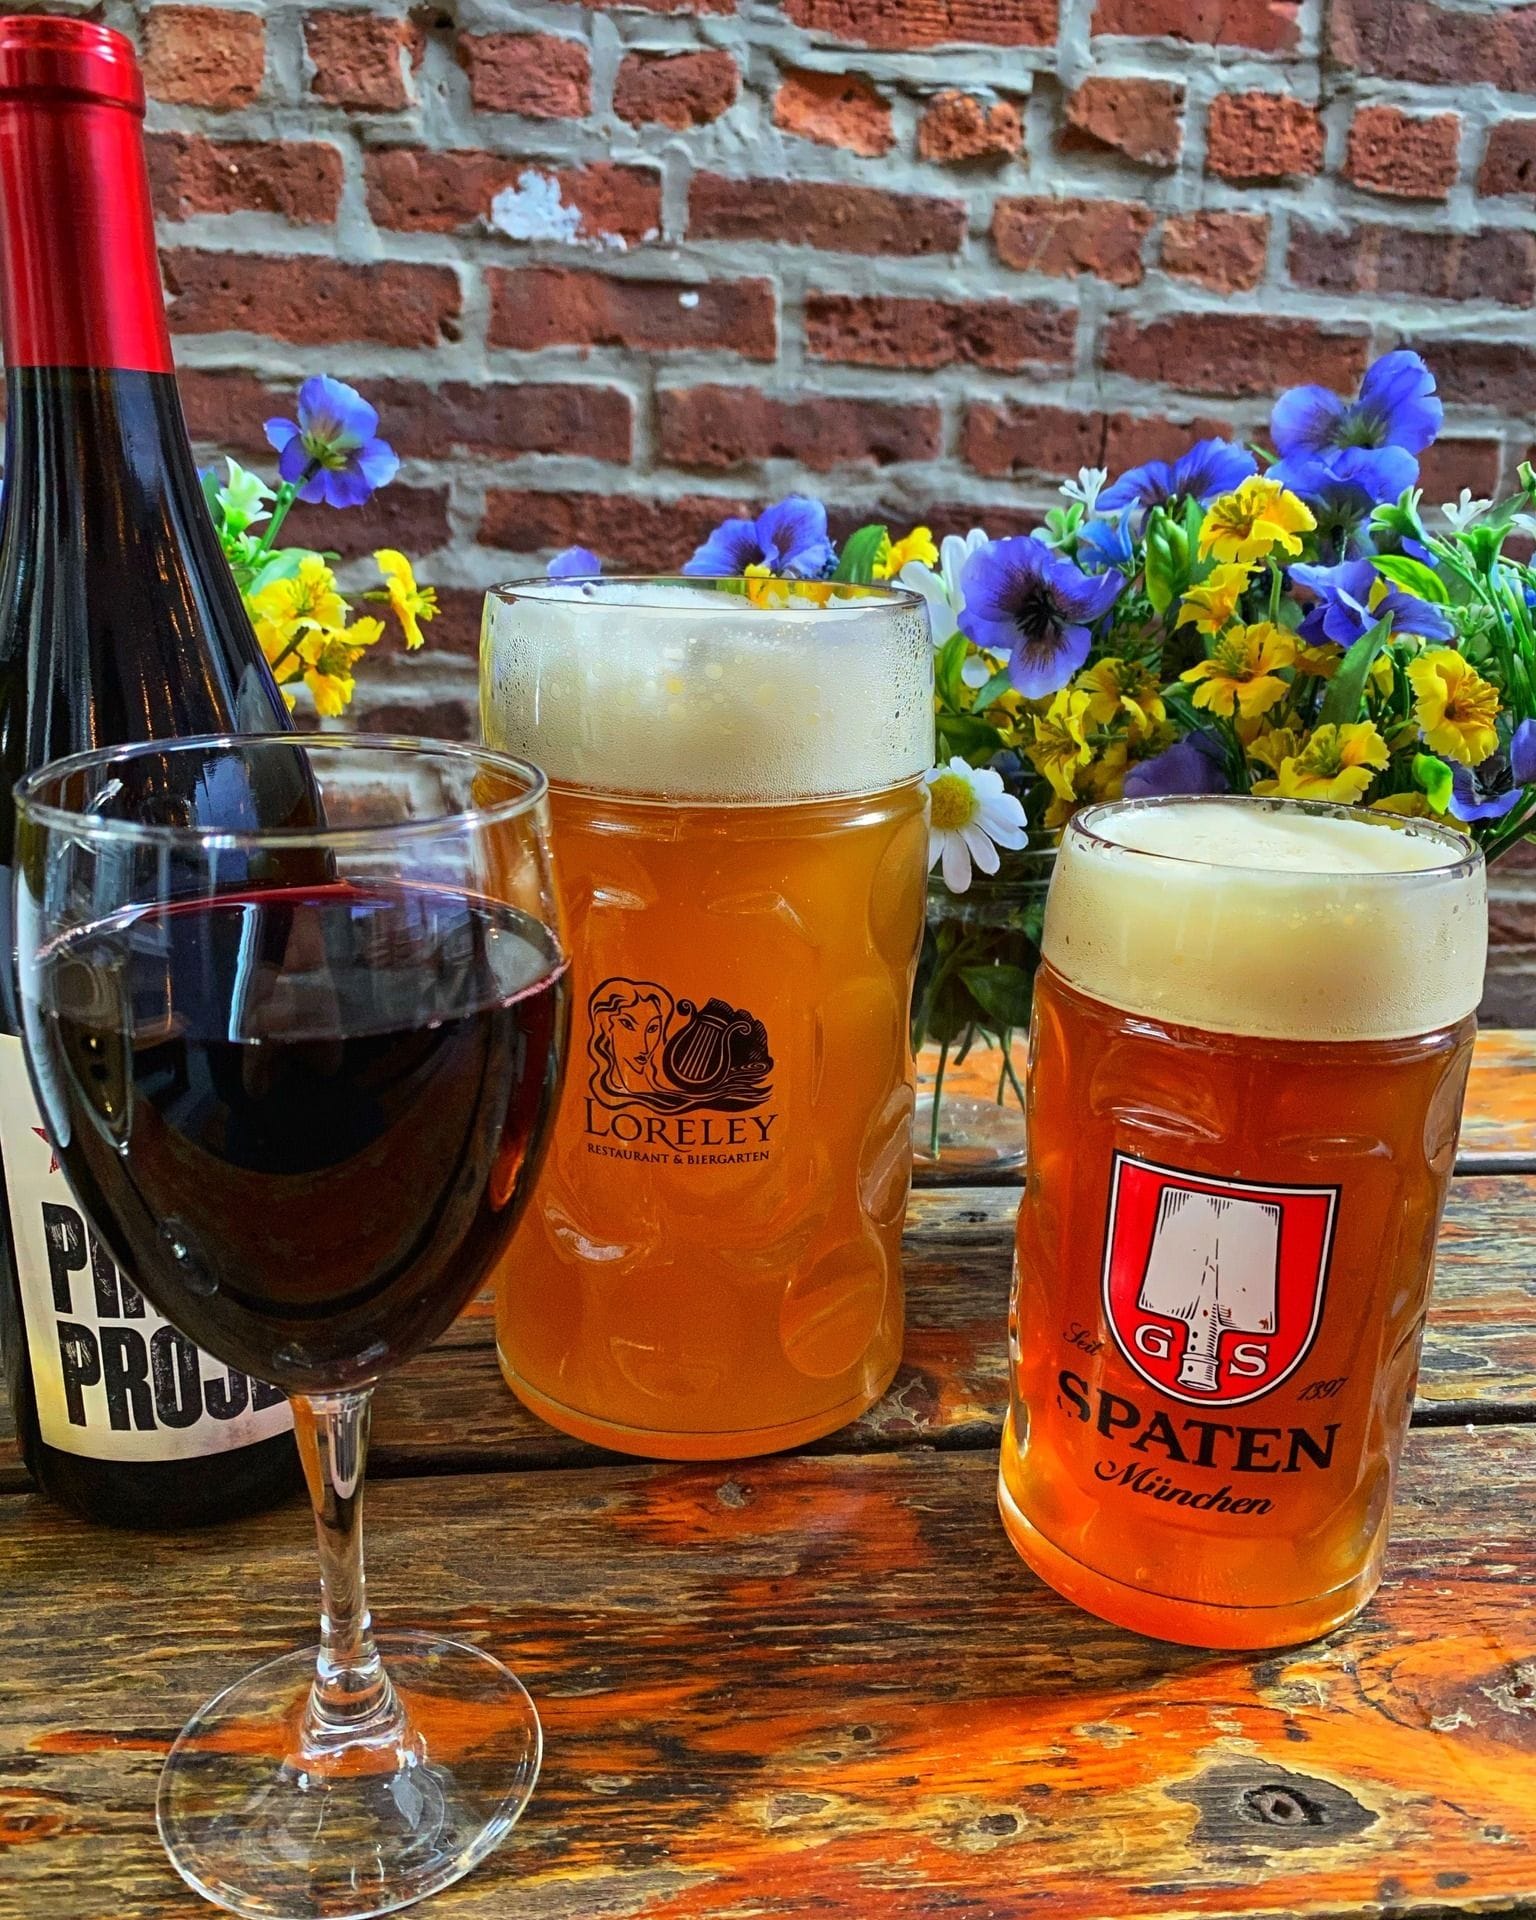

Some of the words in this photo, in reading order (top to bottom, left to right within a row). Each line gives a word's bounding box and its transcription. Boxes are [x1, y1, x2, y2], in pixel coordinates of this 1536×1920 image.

[584, 1097, 778, 1152] LORELEY
[587, 1143, 669, 1164] RESTAURANT
[673, 1154, 683, 1165] &
[687, 1150, 770, 1165] BIERGARTEN
[1063, 1322, 1105, 1356] Seit
[1297, 1376, 1349, 1401] 1397
[1134, 1324, 1174, 1358] G
[1229, 1343, 1268, 1377] S
[1057, 1370, 1342, 1474] SPATEN
[1094, 1460, 1275, 1516] München
